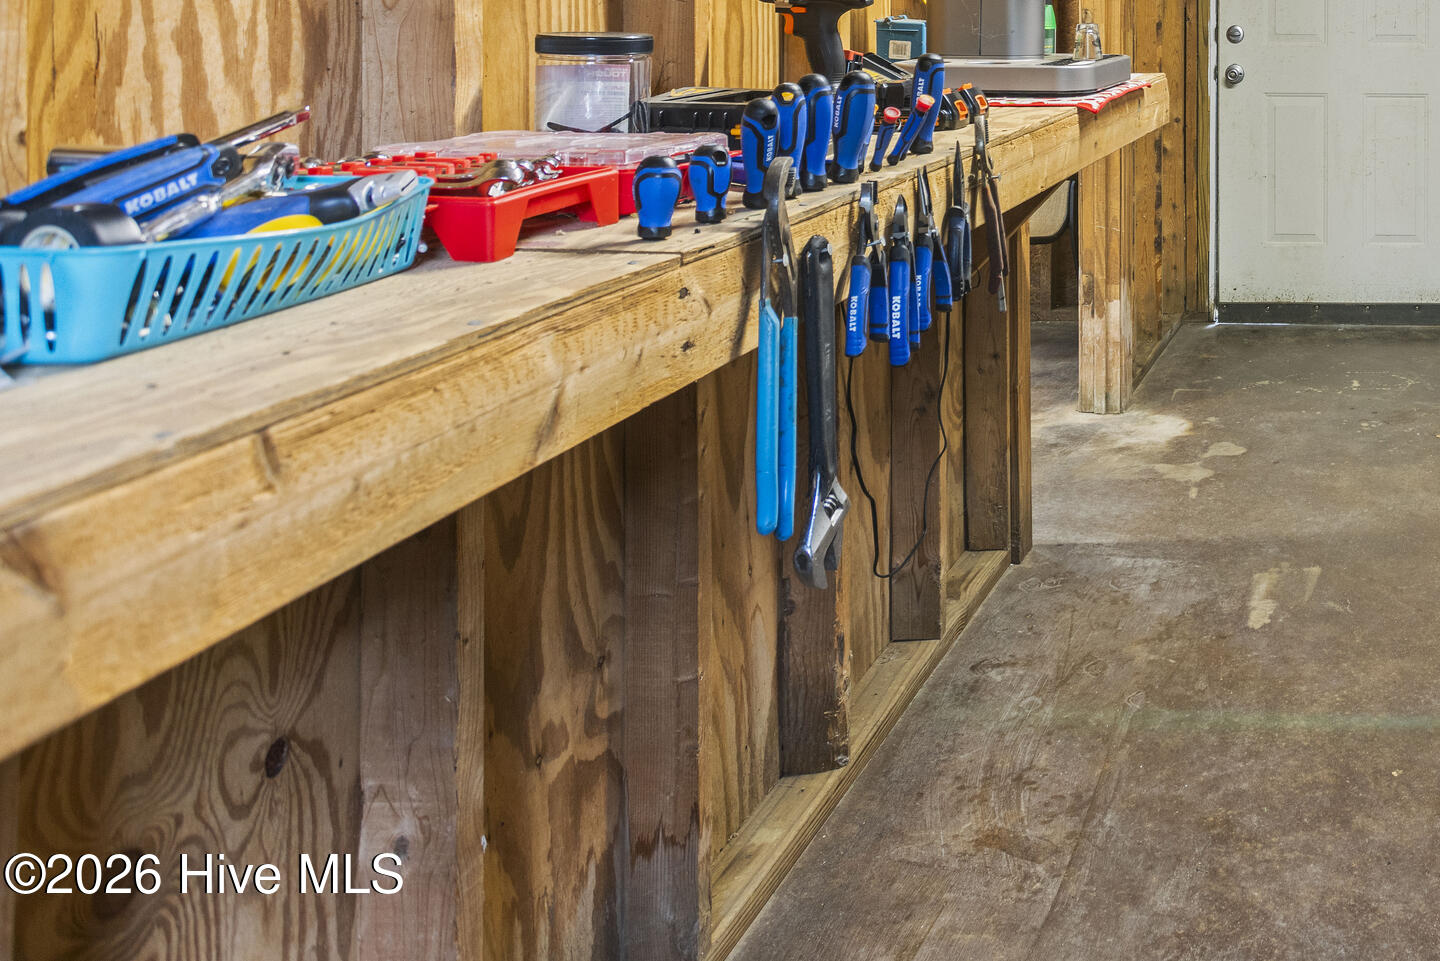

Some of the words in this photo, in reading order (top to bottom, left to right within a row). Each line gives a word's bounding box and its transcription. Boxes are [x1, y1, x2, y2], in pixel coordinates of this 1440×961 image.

[833, 95, 843, 128] KOBALT
[124, 172, 198, 214] KOBALT
[849, 295, 858, 332] KOBALT
[891, 295, 901, 339] KOBALT
